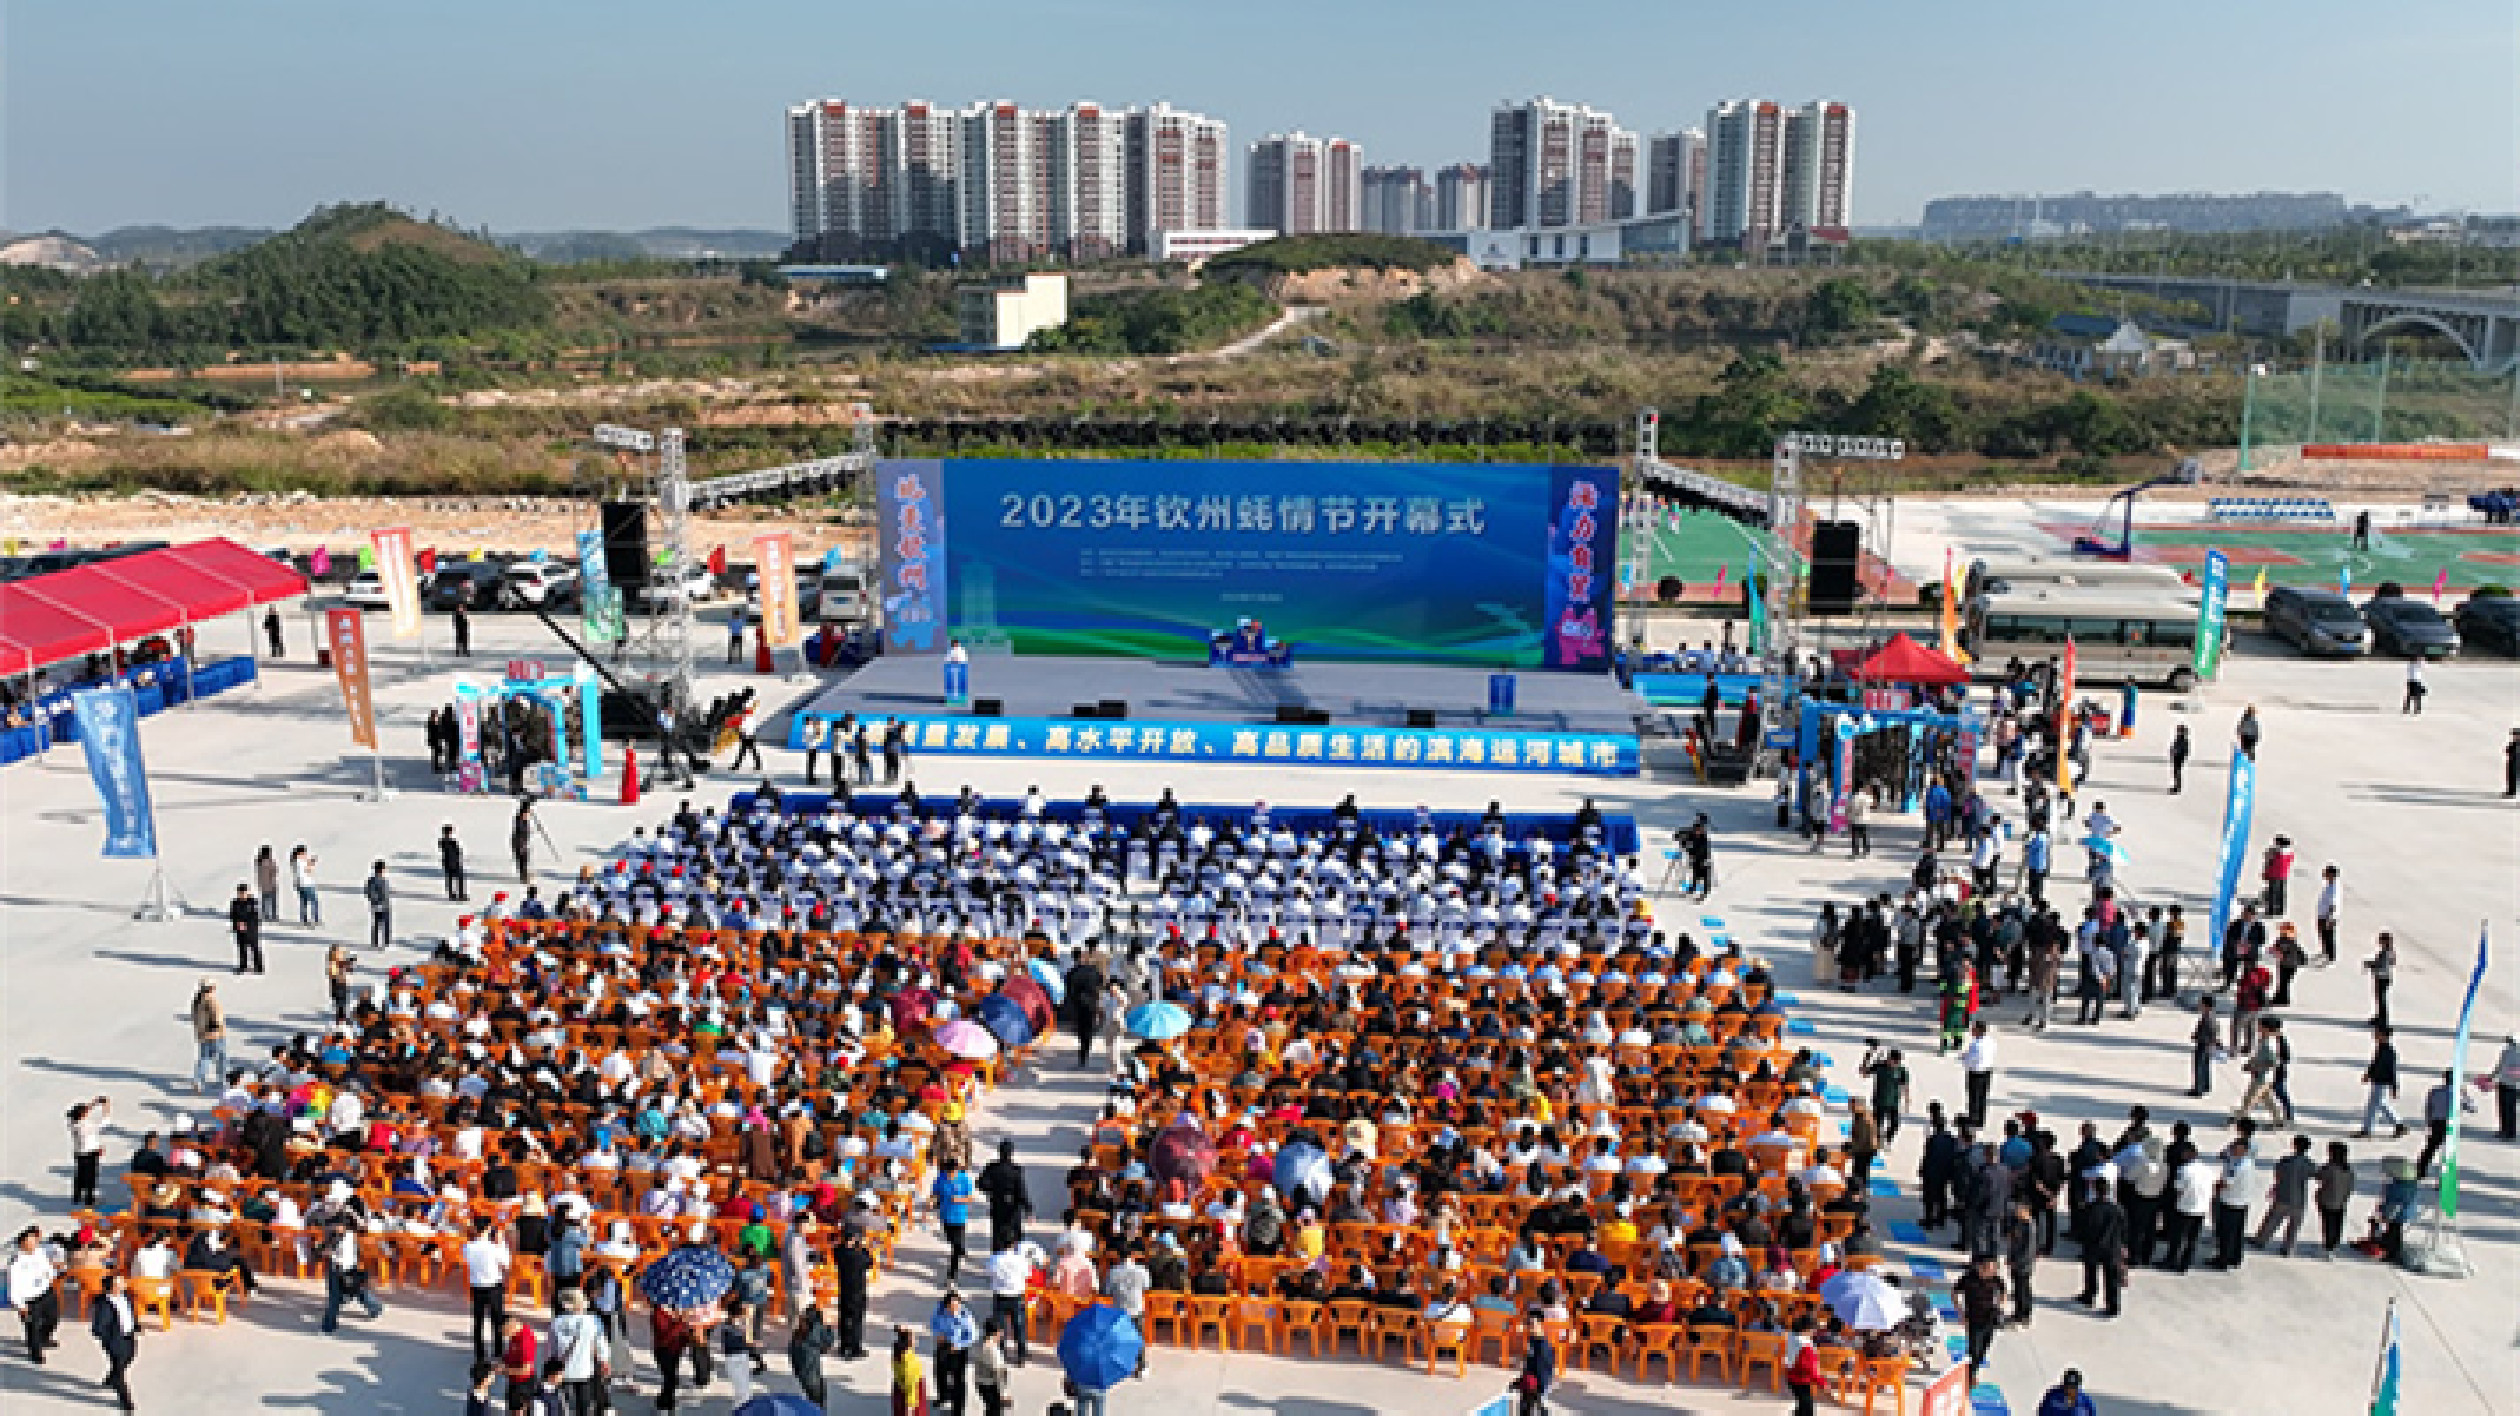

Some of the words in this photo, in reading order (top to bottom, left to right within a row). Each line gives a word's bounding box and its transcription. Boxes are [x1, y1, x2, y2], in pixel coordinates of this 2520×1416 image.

[1000, 492, 1485, 535] 2023年钦州蚝情节开幕式
